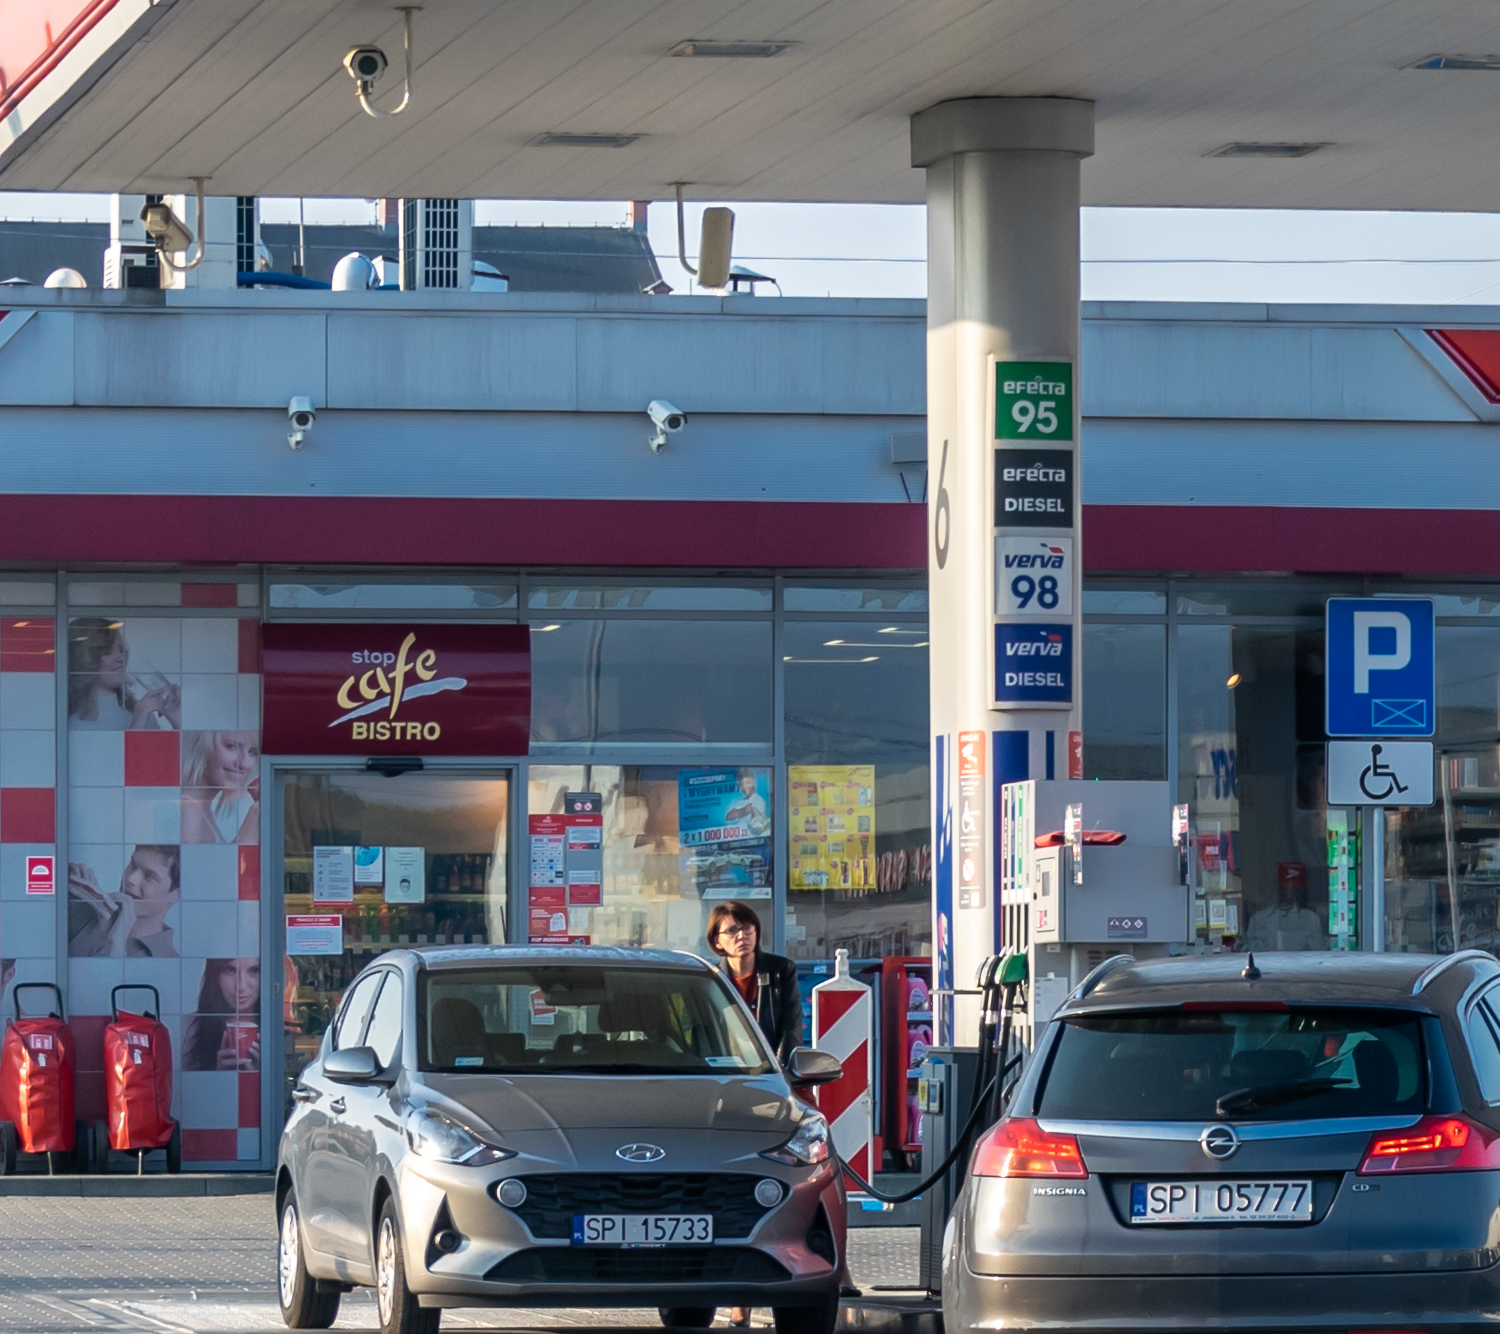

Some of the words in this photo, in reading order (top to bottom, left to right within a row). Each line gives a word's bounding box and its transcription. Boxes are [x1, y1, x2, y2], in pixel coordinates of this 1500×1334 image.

[1011, 400, 1058, 433] 95
[935, 439, 950, 570] 6
[1005, 499, 1065, 512] DIESEL
[1004, 554, 1064, 569] verva
[1011, 575, 1059, 609] 98
[352, 649, 396, 667] stop
[1005, 641, 1062, 657] verva
[1353, 611, 1412, 694] P
[1005, 673, 1064, 686] DIESEL
[352, 721, 441, 741] BISTRO
[1033, 1187, 1086, 1196] INSIGNIA
[1150, 1184, 1199, 1214] SPI
[1217, 1183, 1308, 1213] 05777
[1134, 1205, 1145, 1213] PL
[587, 1218, 626, 1241] SPI
[641, 1218, 710, 1241] 15733
